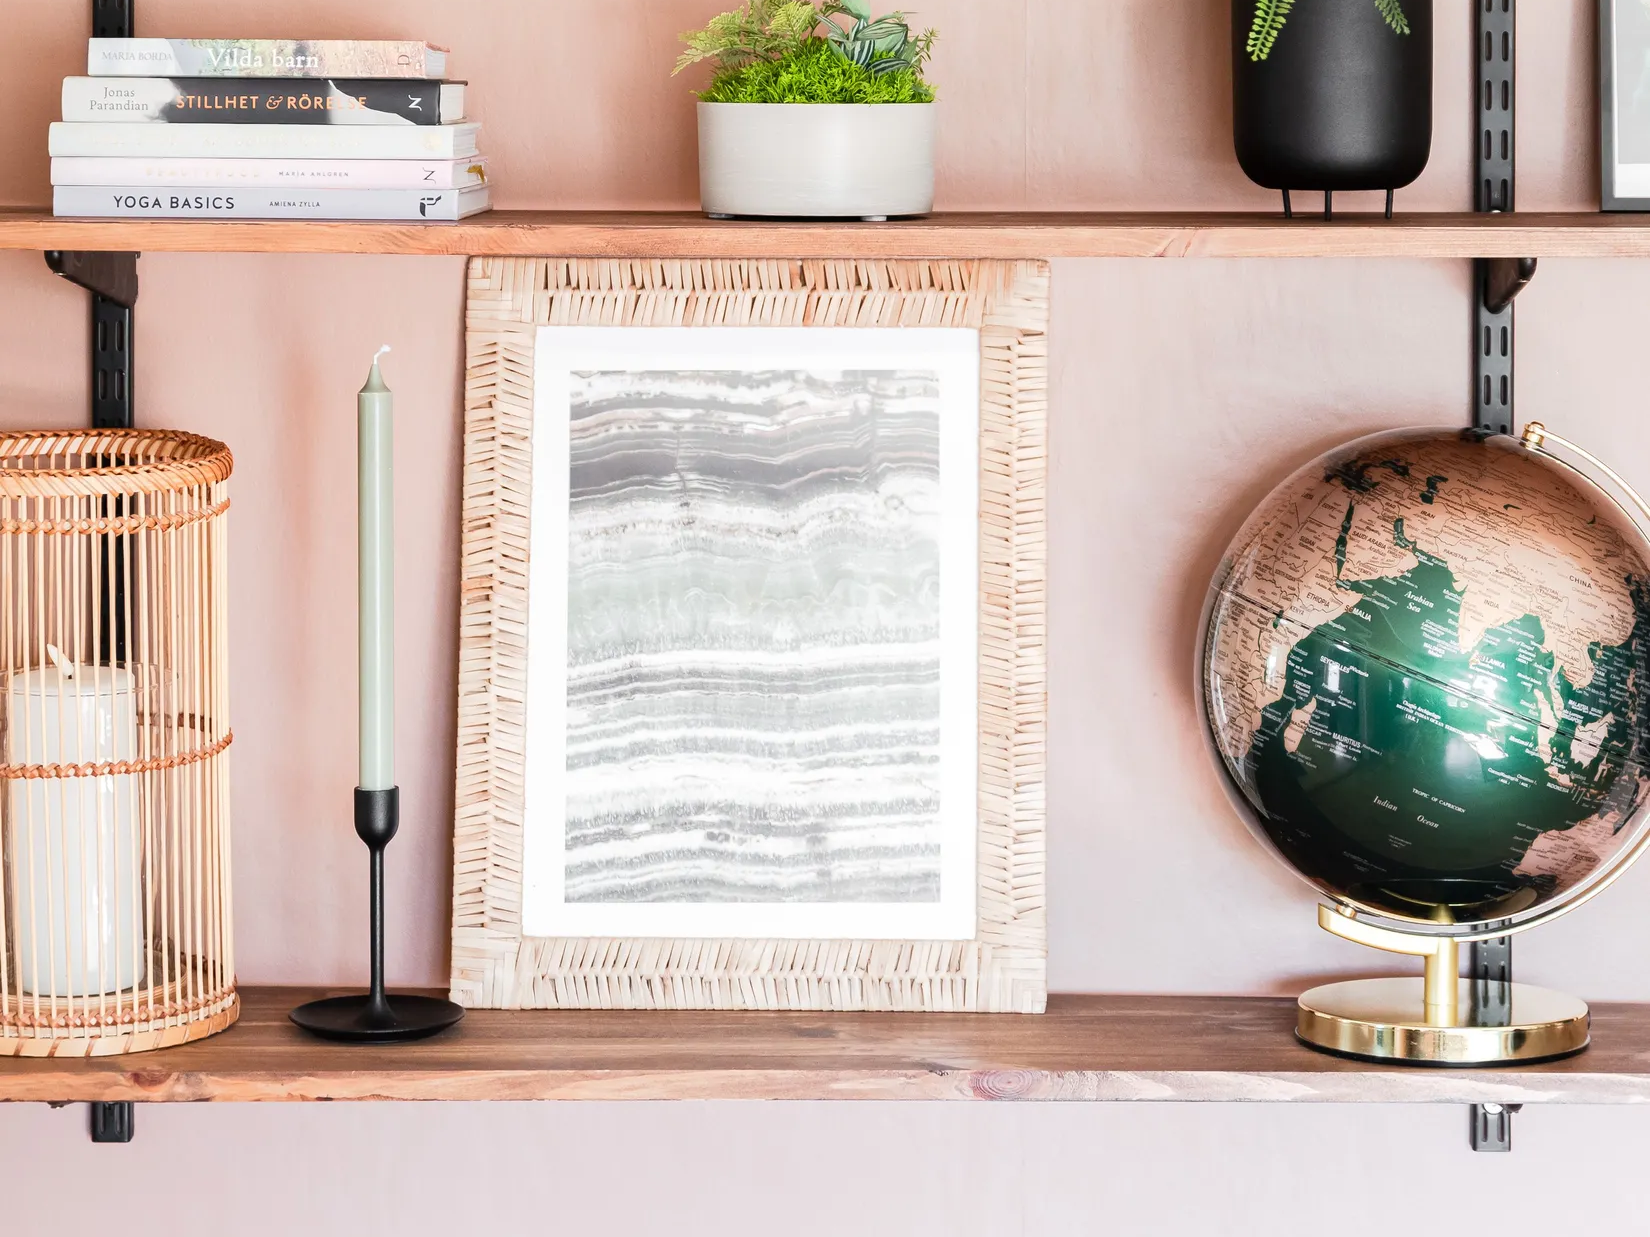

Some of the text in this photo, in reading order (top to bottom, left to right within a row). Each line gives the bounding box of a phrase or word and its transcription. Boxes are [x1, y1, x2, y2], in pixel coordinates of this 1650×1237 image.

[102, 51, 173, 61] MARIA BORDA
[207, 47, 320, 68] Vilda barn
[103, 86, 136, 99] Jonas
[89, 99, 149, 112] Parandian
[176, 94, 367, 110] STILLHET & RÖRELSE
[310, 170, 349, 178] AHLGREN
[113, 195, 235, 210] YOGA BASICS
[269, 200, 297, 208] AMIENA
[1420, 509, 1436, 520] IRAN
[1568, 574, 1593, 590] CHINA
[1306, 591, 1330, 609] ETHIOPIA
[1403, 590, 1434, 608] Arabian
[1483, 598, 1500, 609] INDIA
[1289, 604, 1305, 617] KENYA
[1344, 604, 1372, 622] SOMALIA
[1406, 601, 1421, 613] Sea
[1332, 731, 1361, 749] MAURITIUS
[1373, 795, 1398, 812] Indian
[1412, 787, 1466, 814] TROPIC OF CAPRICORN
[1416, 814, 1440, 829] Ocean
